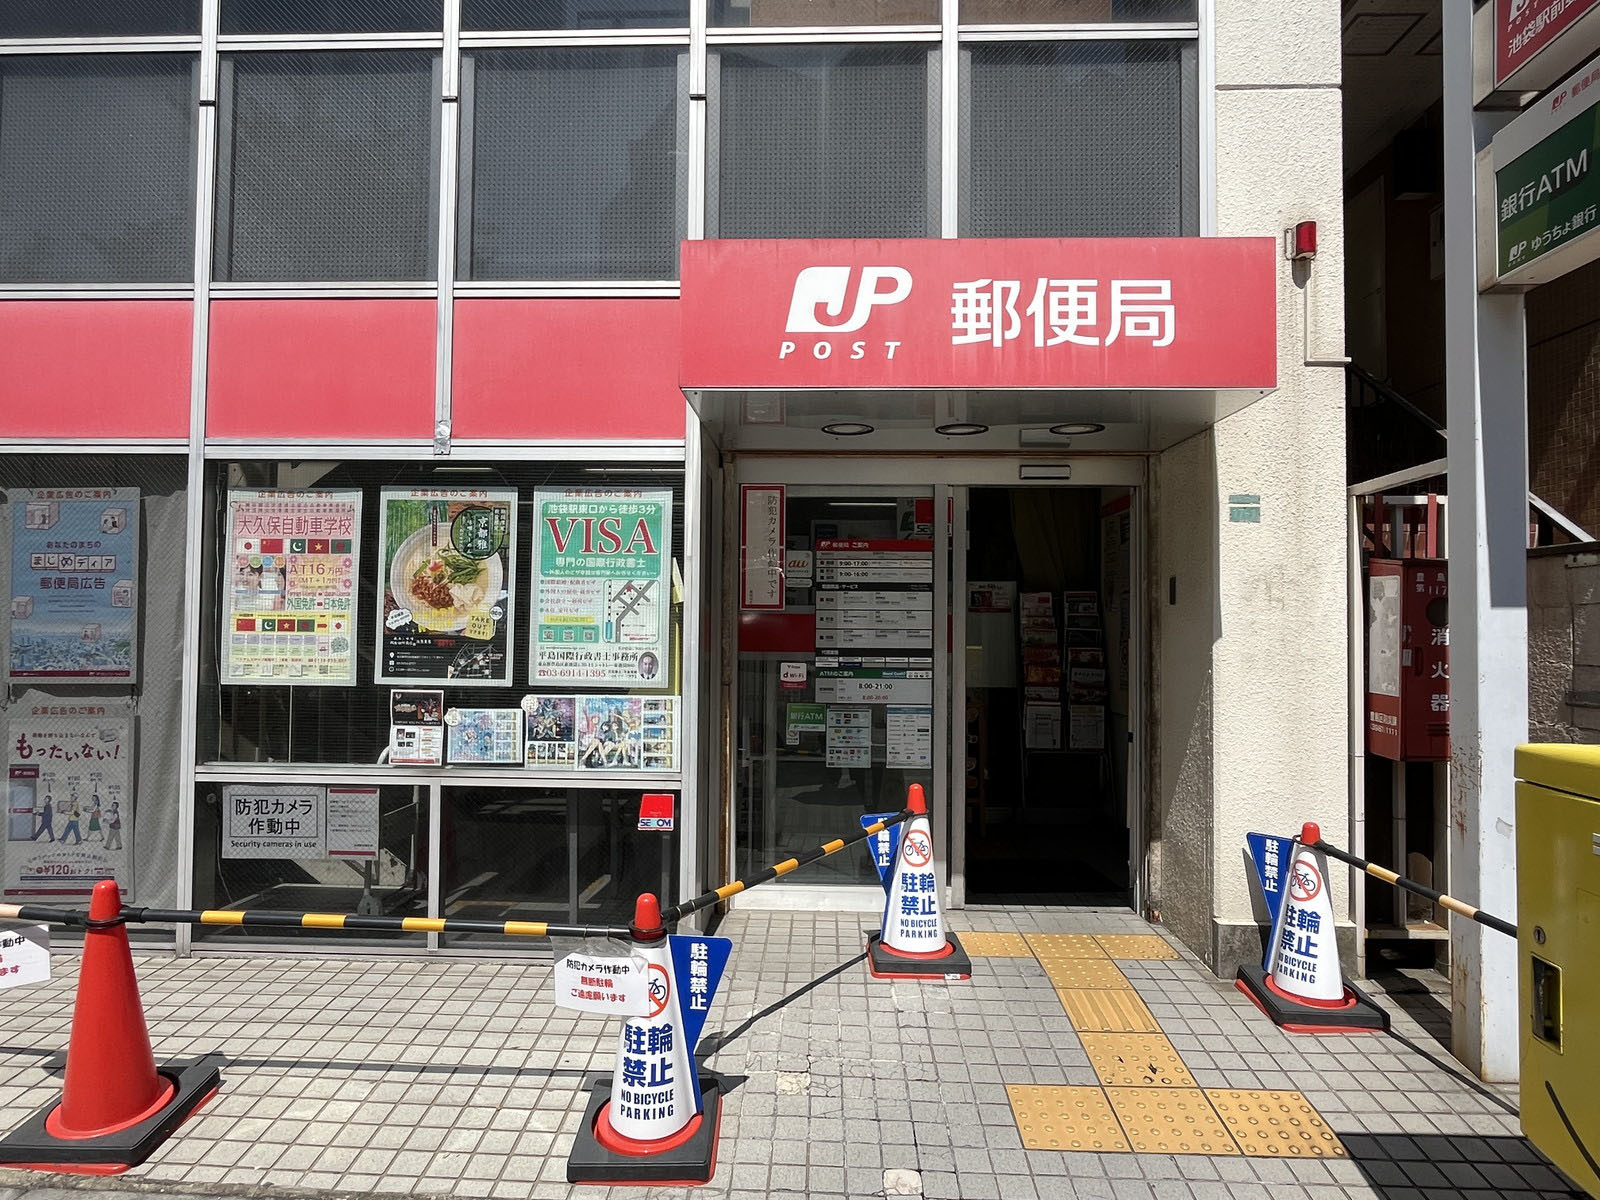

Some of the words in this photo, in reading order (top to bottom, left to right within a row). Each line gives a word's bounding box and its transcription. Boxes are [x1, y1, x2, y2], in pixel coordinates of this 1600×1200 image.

[1508, 0, 1577, 58] 池袋駅前
[1500, 148, 1589, 223] 銀行ATM
[1531, 204, 1597, 251] ゆうちょ銀行
[785, 266, 912, 333] JP
[951, 277, 1175, 348] 郵便局
[779, 340, 904, 360] POST
[547, 504, 656, 514] 池袋駅東口から徒歩3分
[238, 516, 352, 536] 大久保自動車学校
[545, 517, 659, 555] VISA
[32, 555, 113, 570] まじめディア
[555, 557, 646, 568] 専門の国際行政書士
[788, 560, 809, 569] au
[39, 577, 106, 590] 郵便局広告
[471, 615, 490, 623] TAKE
[790, 712, 824, 721] 銀行ATM
[235, 799, 313, 816] 防犯カメラ
[248, 818, 300, 835] 作動中
[231, 840, 261, 849] Security
[295, 840, 302, 848] in
[1265, 839, 1279, 893] 駐輪禁止
[901, 872, 935, 893] 駐輪
[901, 895, 936, 916] 禁止
[900, 918, 909, 927] NO
[910, 918, 937, 928] BICYCLE
[900, 930, 938, 939] PARKING
[1281, 928, 1318, 959] 禁止
[566, 959, 630, 974] 防犯カメラ作動中
[1284, 954, 1317, 973] BICYCLE
[581, 976, 613, 988] 無断駐輪
[690, 942, 708, 1011] 駐輪禁止
[571, 988, 627, 1003] ご遠慮願います
[624, 1023, 673, 1055] 駐輪
[623, 1056, 674, 1088] 禁止
[621, 1089, 631, 1102] NO
[634, 1089, 674, 1105] BICYCLE
[620, 1105, 674, 1120] PARKING
